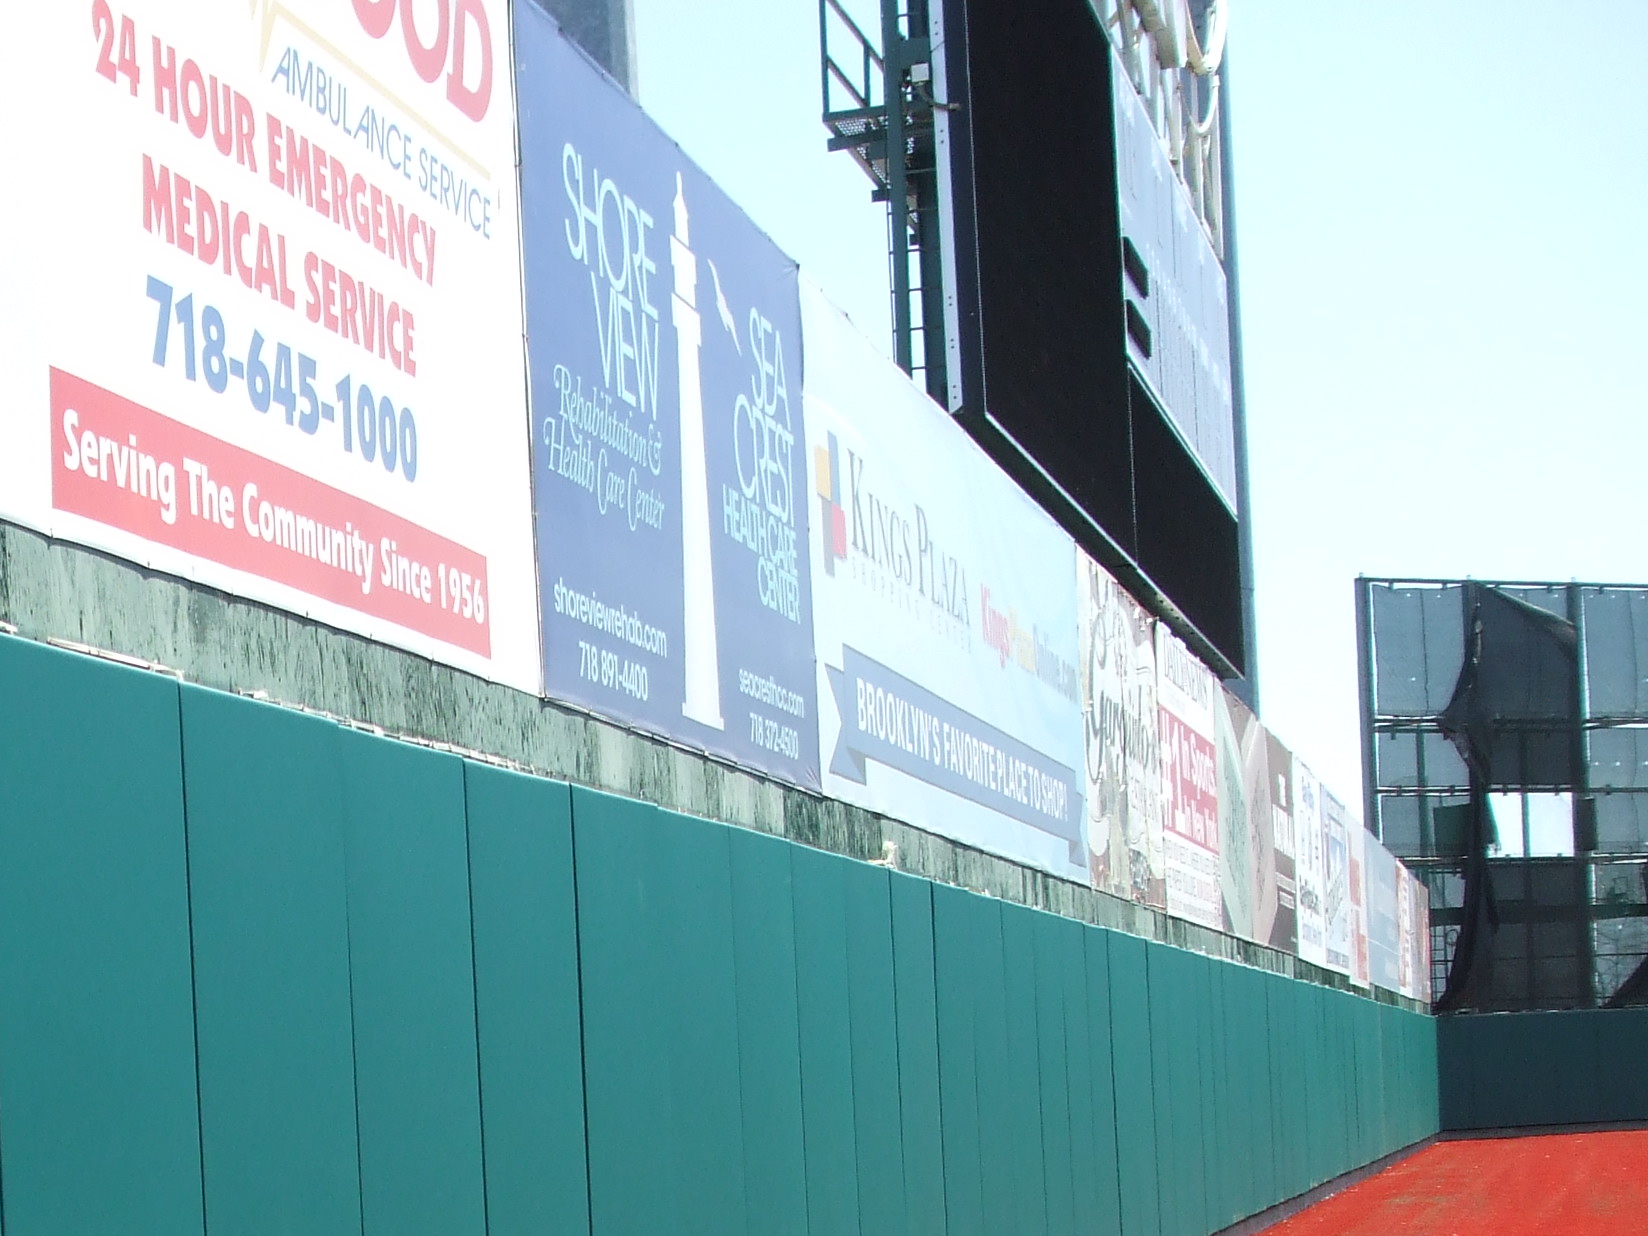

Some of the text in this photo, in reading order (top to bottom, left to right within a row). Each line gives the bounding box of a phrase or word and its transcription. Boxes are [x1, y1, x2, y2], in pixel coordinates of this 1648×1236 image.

[92, 0, 436, 287] 24 HOUR EMERGENCY
[271, 46, 491, 240] AMBULANCE SERVICE
[142, 153, 417, 378] MEDICAL SERVICE
[563, 142, 659, 321] SHORE
[146, 274, 417, 483] 718-645-1000
[590, 271, 659, 421] VIEW
[749, 307, 791, 431] SEA
[543, 416, 665, 532] Health Care Center
[553, 364, 662, 476] Rehabilitation &
[733, 394, 794, 528] CREST
[63, 408, 485, 625] Serving The Community Since 1956
[847, 447, 970, 627] KINGS PLAZA
[553, 576, 668, 659] shoreviewrehab.com
[757, 556, 801, 625] CENTER
[578, 641, 648, 701] 718 891-4400
[857, 677, 940, 766] BROOKLYN'S
[943, 722, 996, 790] FAVORITE
[997, 750, 1028, 804] PLACE
[1026, 766, 1040, 812] TO
[1040, 774, 1068, 822] SHOP!
